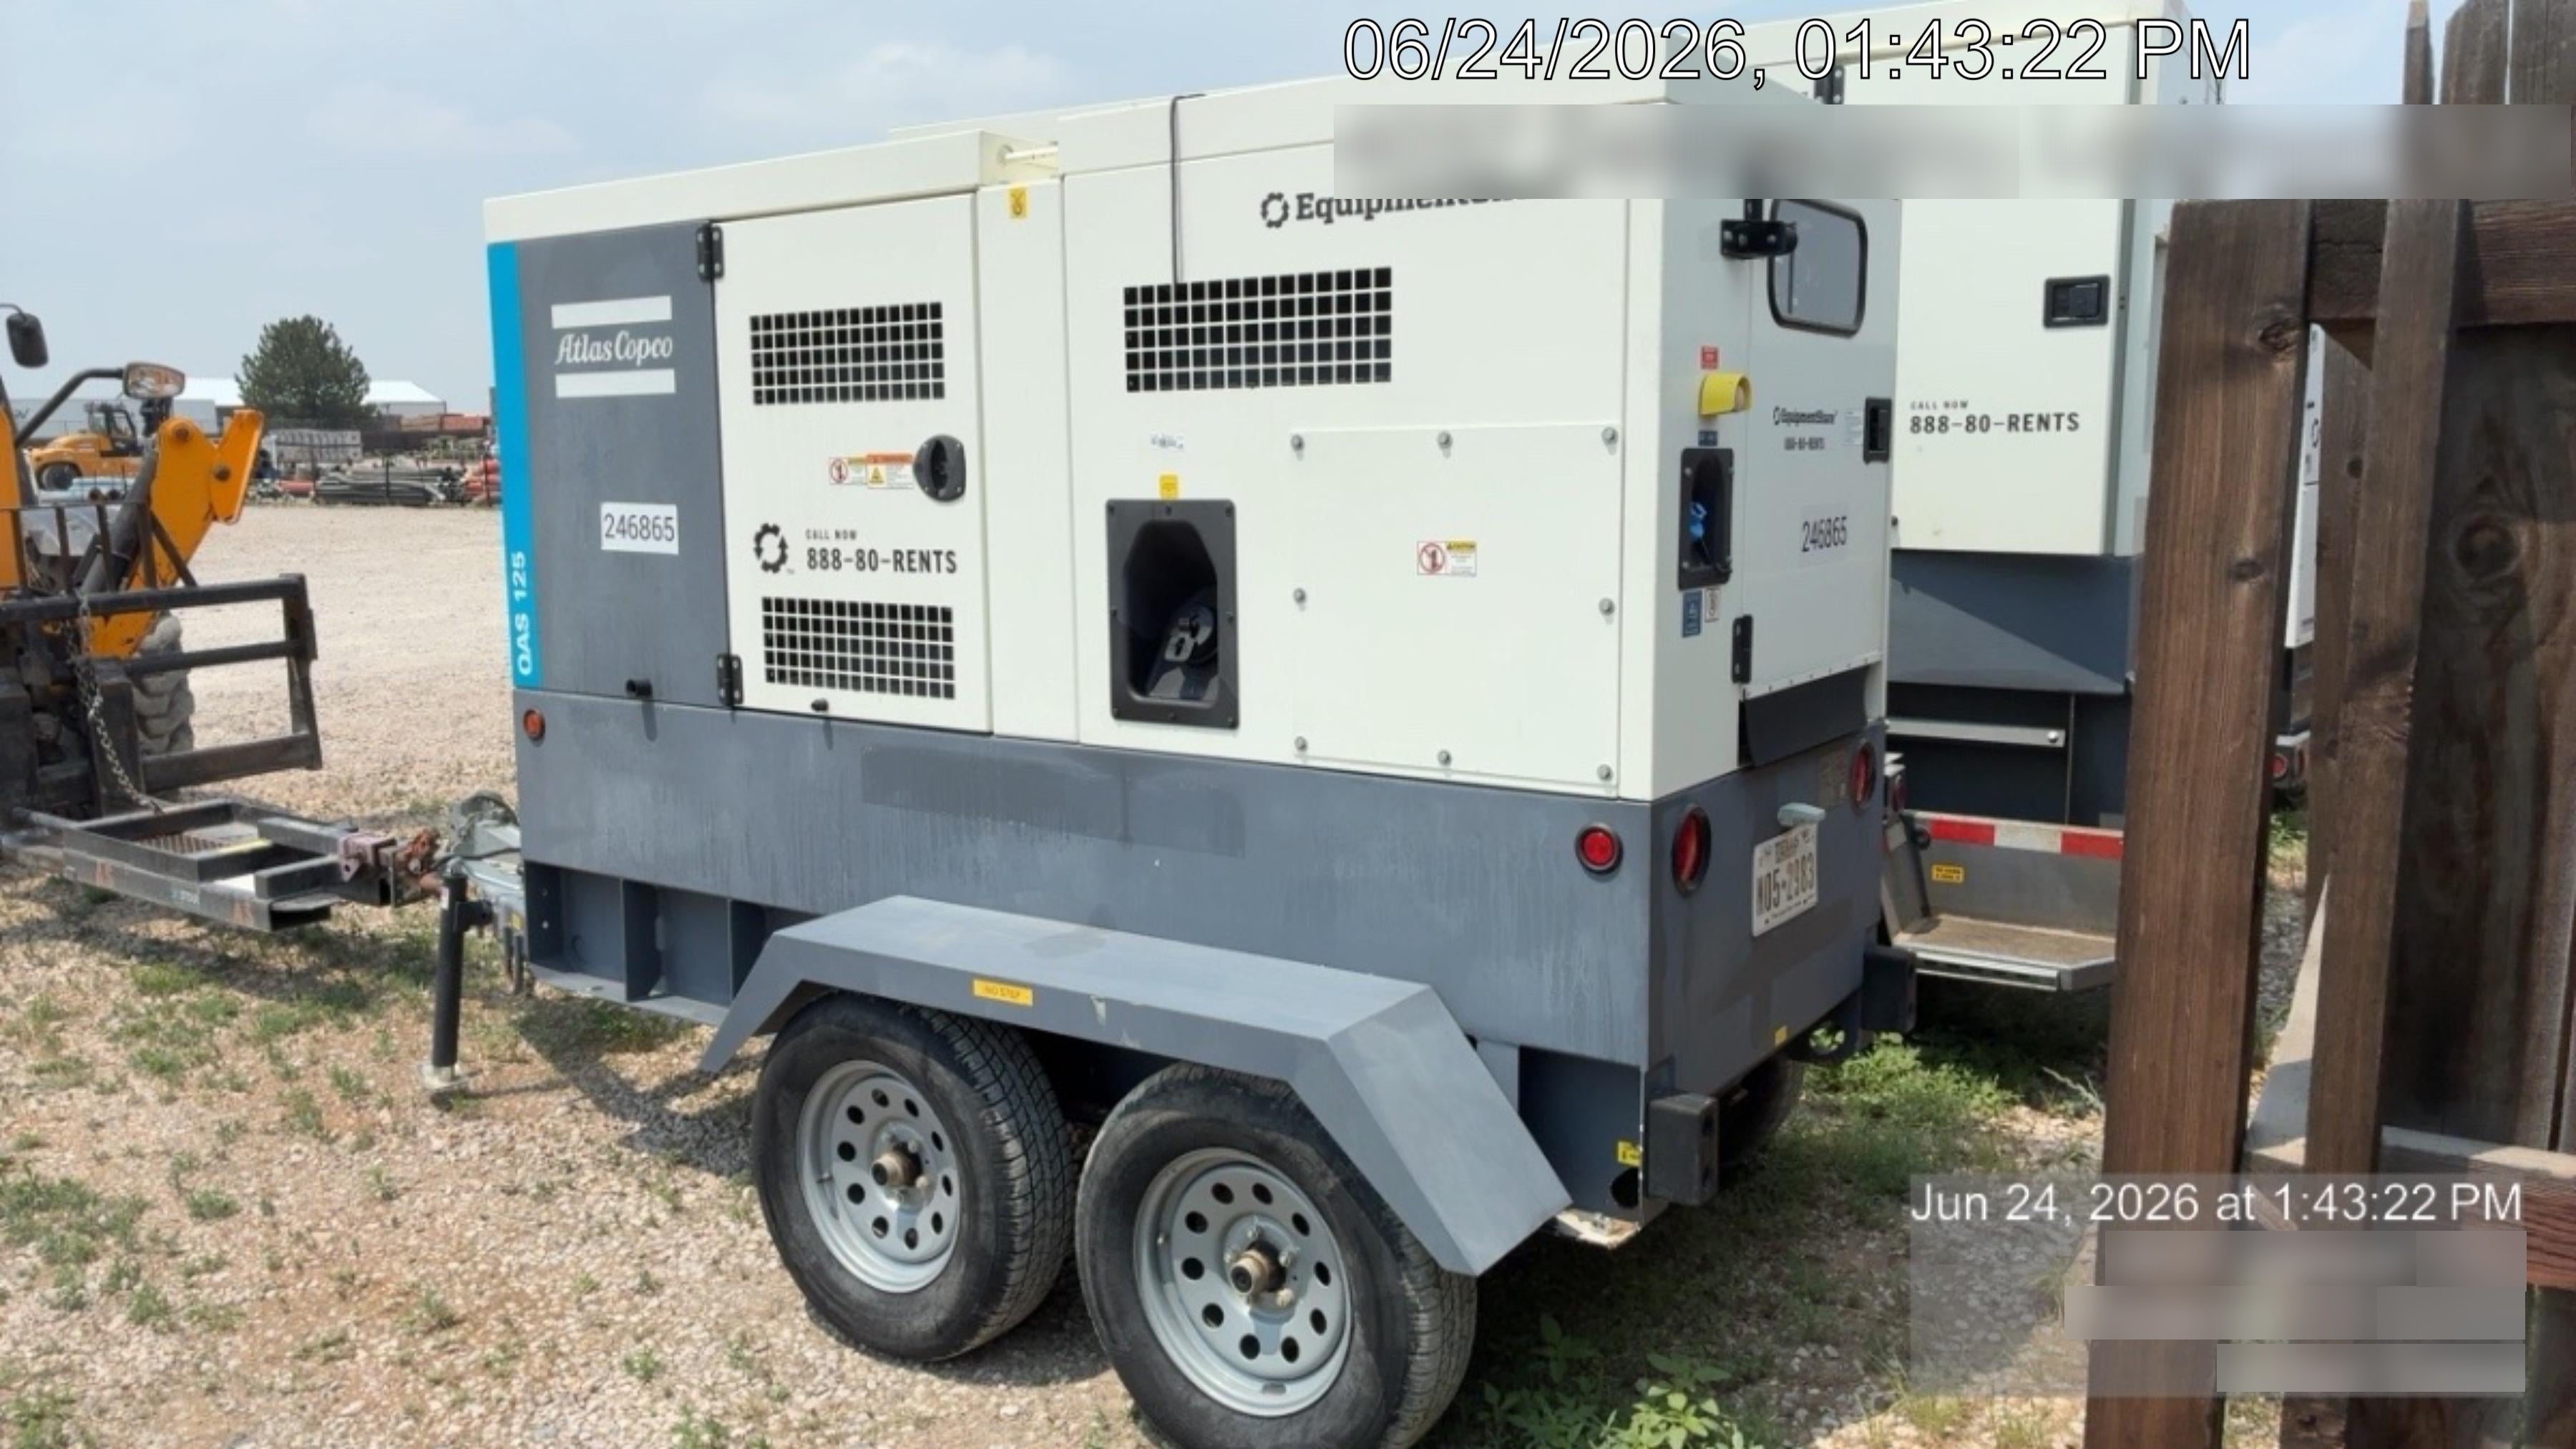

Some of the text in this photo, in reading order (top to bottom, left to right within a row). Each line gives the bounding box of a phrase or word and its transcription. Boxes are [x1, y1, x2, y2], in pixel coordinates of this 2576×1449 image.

[554, 330, 673, 368] Atlas Copco
[1909, 411, 2079, 434] 888-80-RENTS
[605, 513, 675, 542] 246865
[806, 530, 857, 540] CALL NOW
[807, 547, 957, 574] 888-80-RENTS
[511, 551, 527, 602] 125
